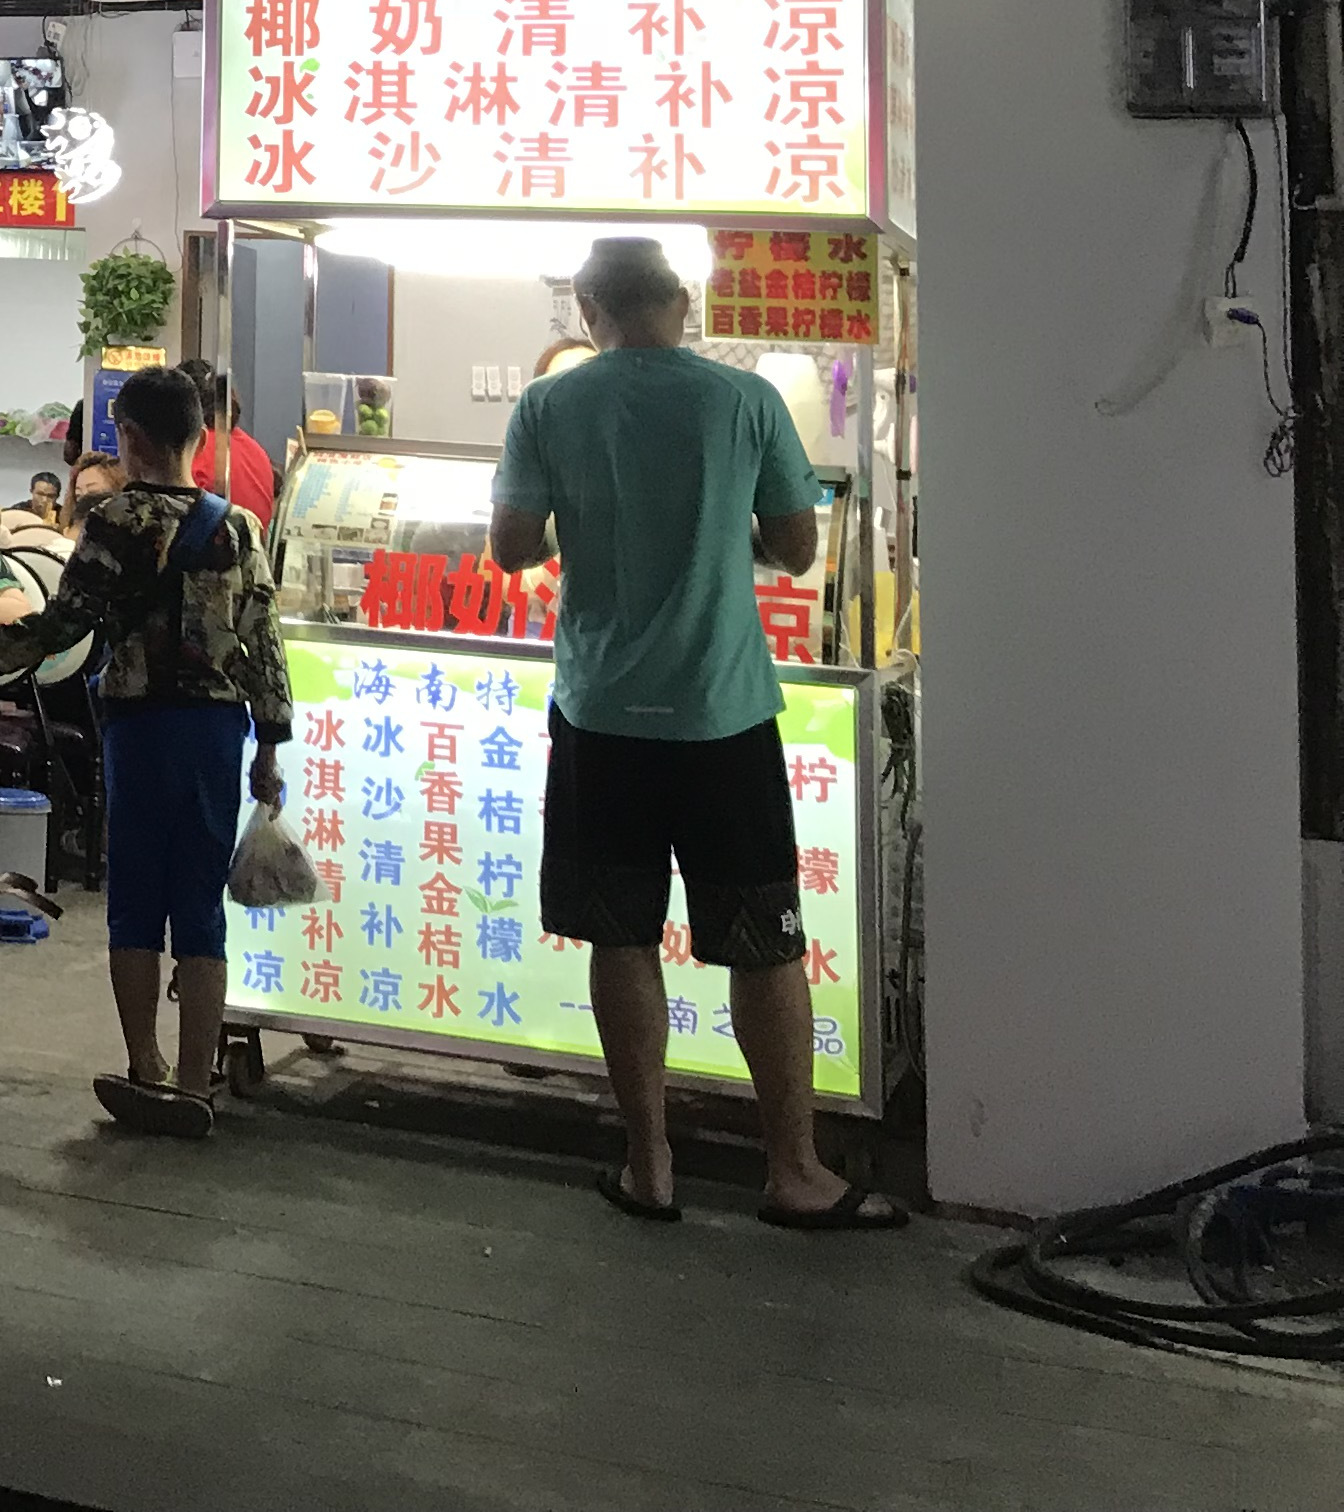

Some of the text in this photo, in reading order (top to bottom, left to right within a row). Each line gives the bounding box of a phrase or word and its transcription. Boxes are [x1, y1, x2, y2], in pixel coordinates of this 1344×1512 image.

[244, 59, 846, 131] 冰淇淋清补凉
[244, 128, 846, 203] 冰沙清补凉
[711, 304, 872, 340] 百香果柠檬水
[352, 657, 555, 718] 海南特
[358, 715, 406, 1013] 冰沙清补凉
[417, 720, 465, 1020] 百香果金桔水
[476, 725, 524, 1028] 金桔柠檬水
